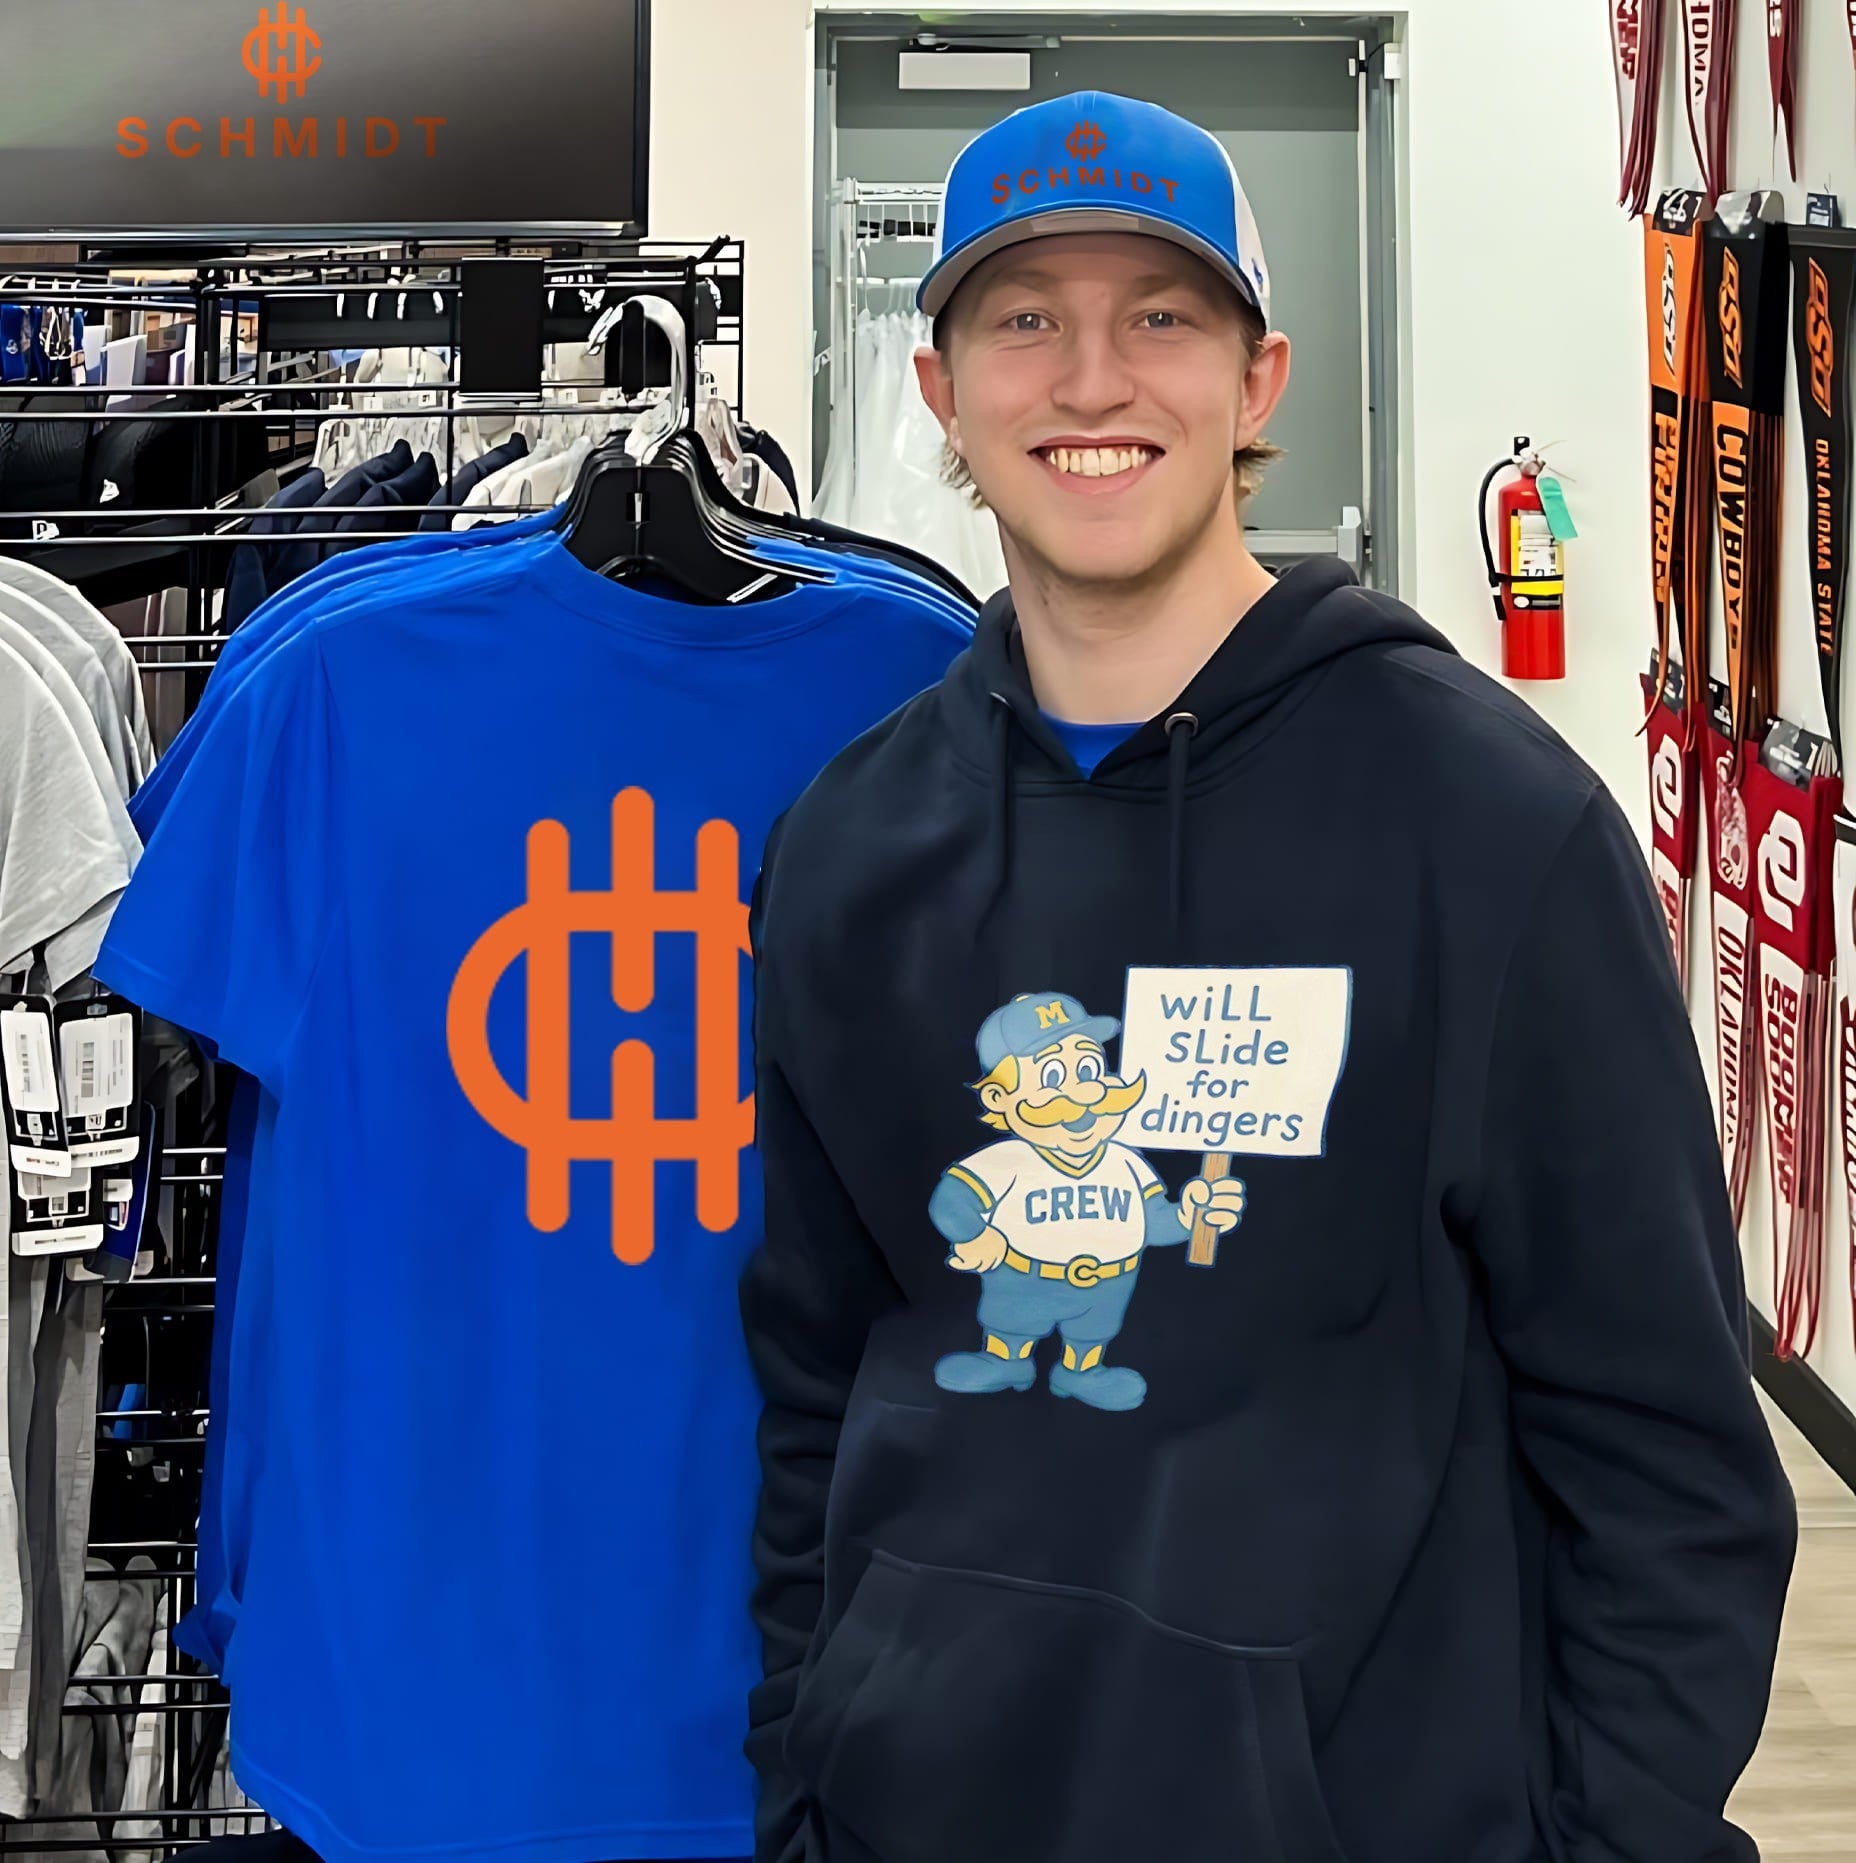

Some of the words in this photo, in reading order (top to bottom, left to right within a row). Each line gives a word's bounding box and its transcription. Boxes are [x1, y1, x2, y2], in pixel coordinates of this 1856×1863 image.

[115, 116, 447, 159] SCHMIDT
[991, 167, 1179, 204] SCHMIDT
[1815, 438, 1832, 570] OKLAHOMA
[1034, 1001, 1071, 1030] M
[1718, 925, 1745, 1144] OKLAHOMA
[1186, 1069, 1250, 1099] for
[1140, 1093, 1303, 1147] dingers
[1024, 1184, 1133, 1225] CREW
